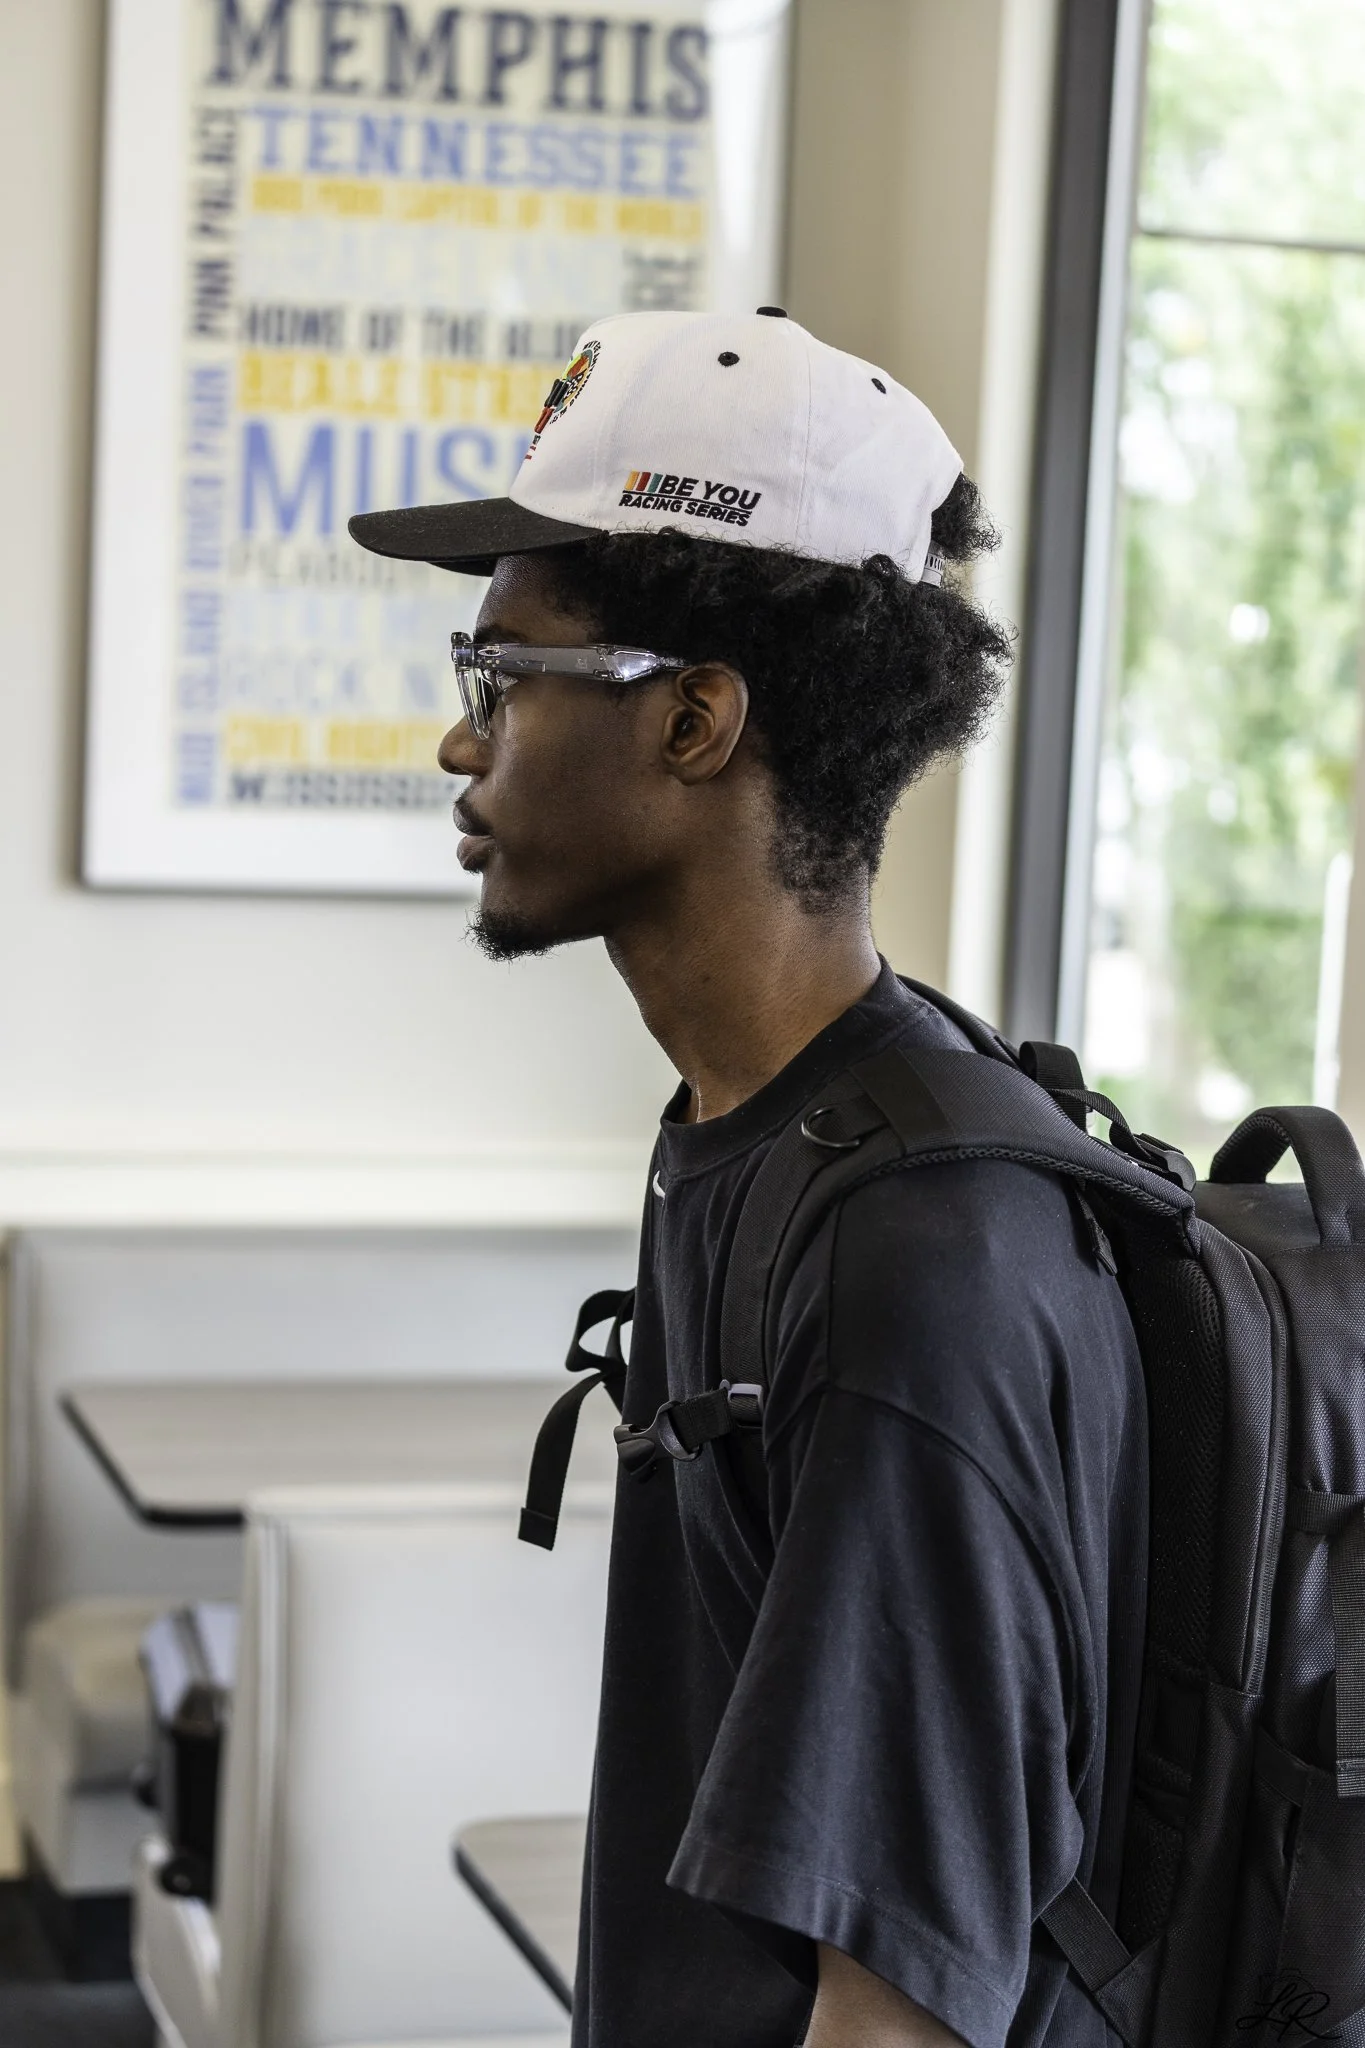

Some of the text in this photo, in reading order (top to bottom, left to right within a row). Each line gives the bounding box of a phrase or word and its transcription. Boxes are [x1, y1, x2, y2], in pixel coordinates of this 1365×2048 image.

[203, 0, 711, 121] MEMPHIS
[247, 106, 703, 198] TENNESSEE
[618, 493, 751, 527] RACING SERIES
[659, 474, 761, 510] BE YOU
